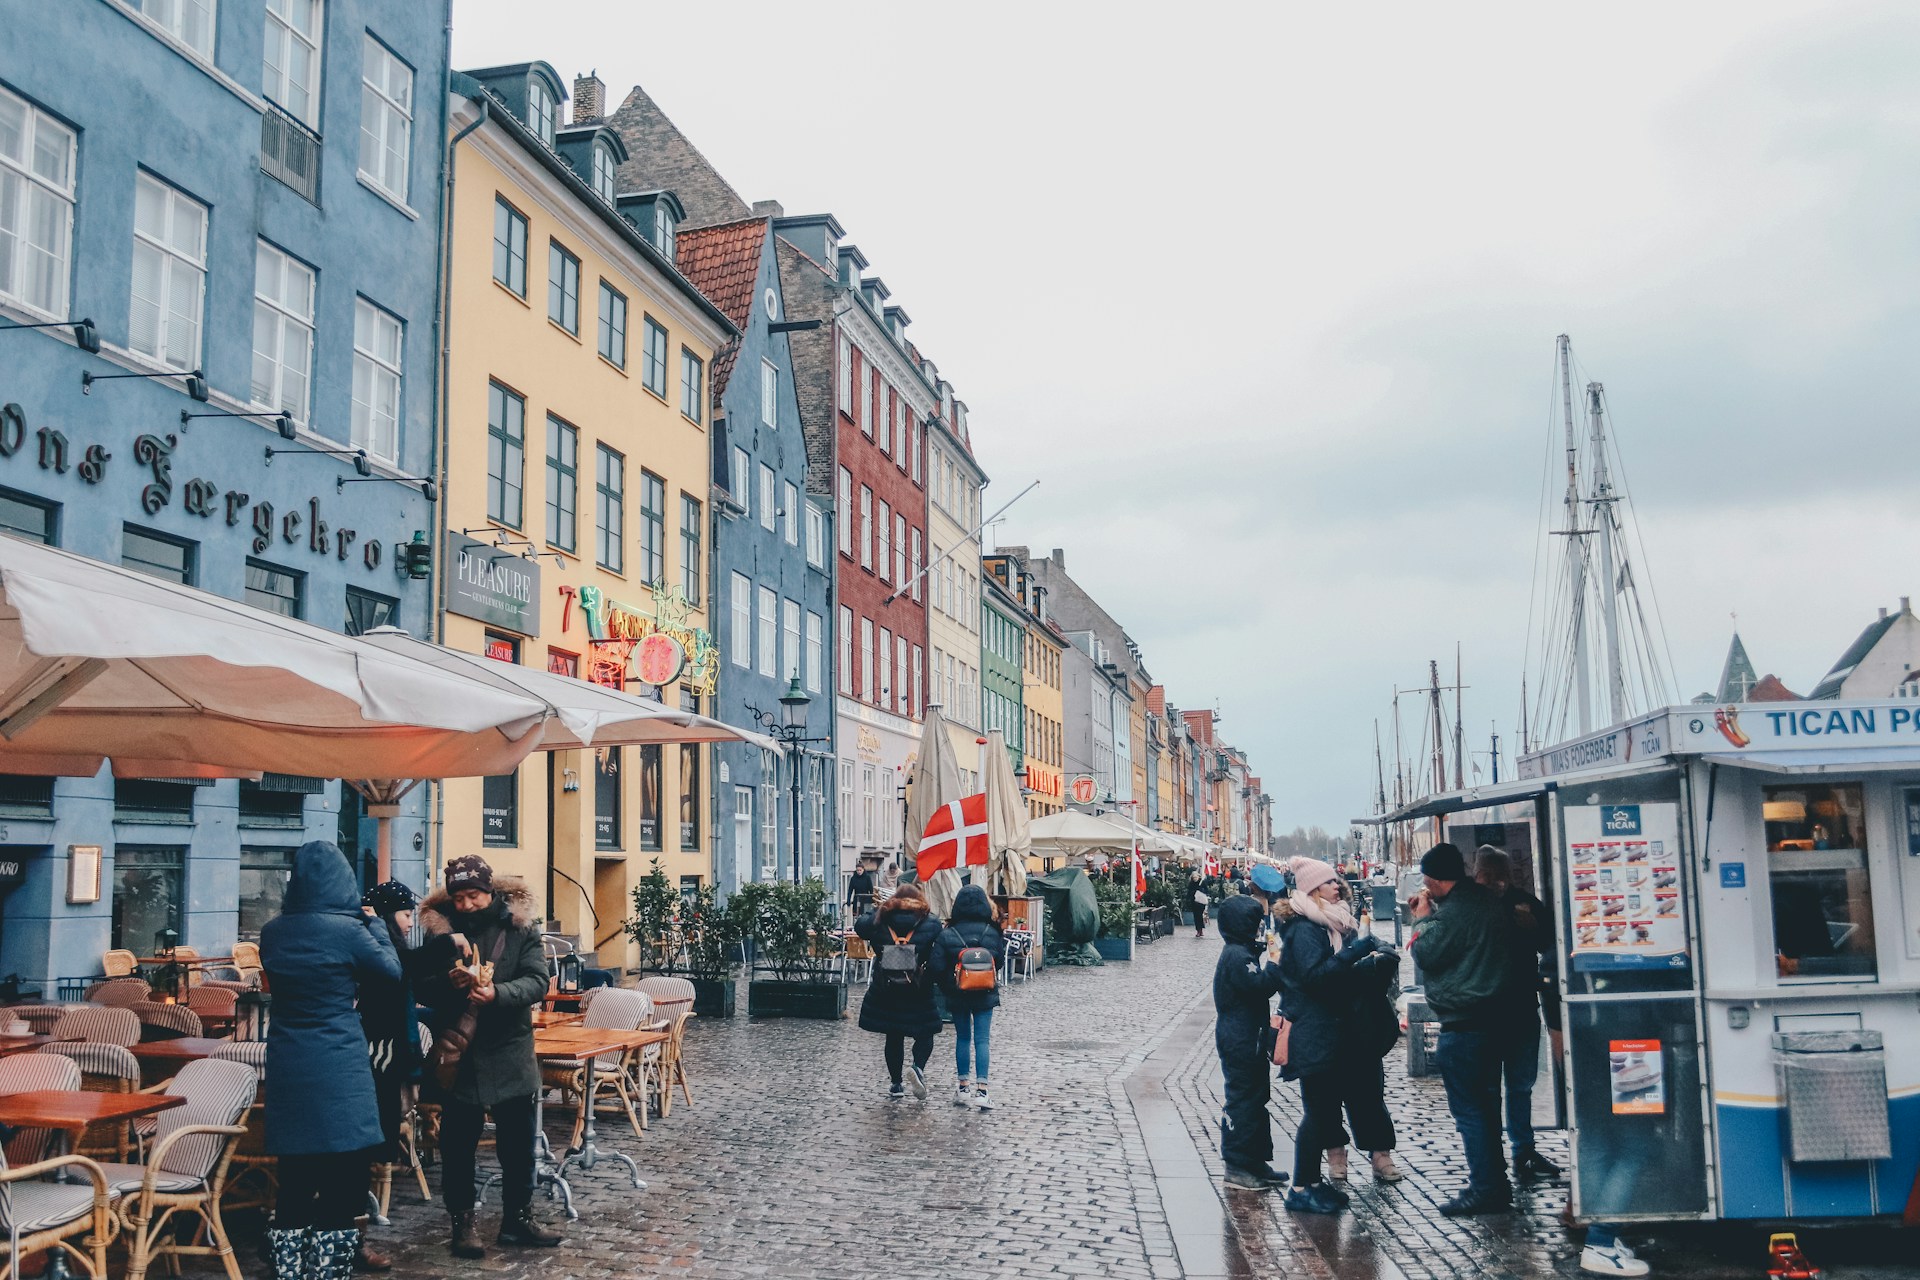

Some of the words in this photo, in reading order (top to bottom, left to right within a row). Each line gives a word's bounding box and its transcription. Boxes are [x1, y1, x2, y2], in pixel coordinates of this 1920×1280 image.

[134, 432, 382, 570] Færgekro
[458, 550, 531, 604] PLEASURE
[472, 592, 505, 611] GENTLEMENS
[505, 603, 517, 614] CLUB
[558, 585, 577, 633] 7
[485, 642, 513, 662] PLEASURE
[1765, 709, 1876, 736] TICAN
[1551, 752, 1569, 773] MIA'S
[1571, 735, 1617, 767] FODERBRÆT
[1641, 737, 1661, 755] TICAN
[1072, 780, 1093, 801] 17
[489, 817, 503, 828] 21-05
[1606, 821, 1636, 830] TICAN
[0, 861, 19, 876] KRO
